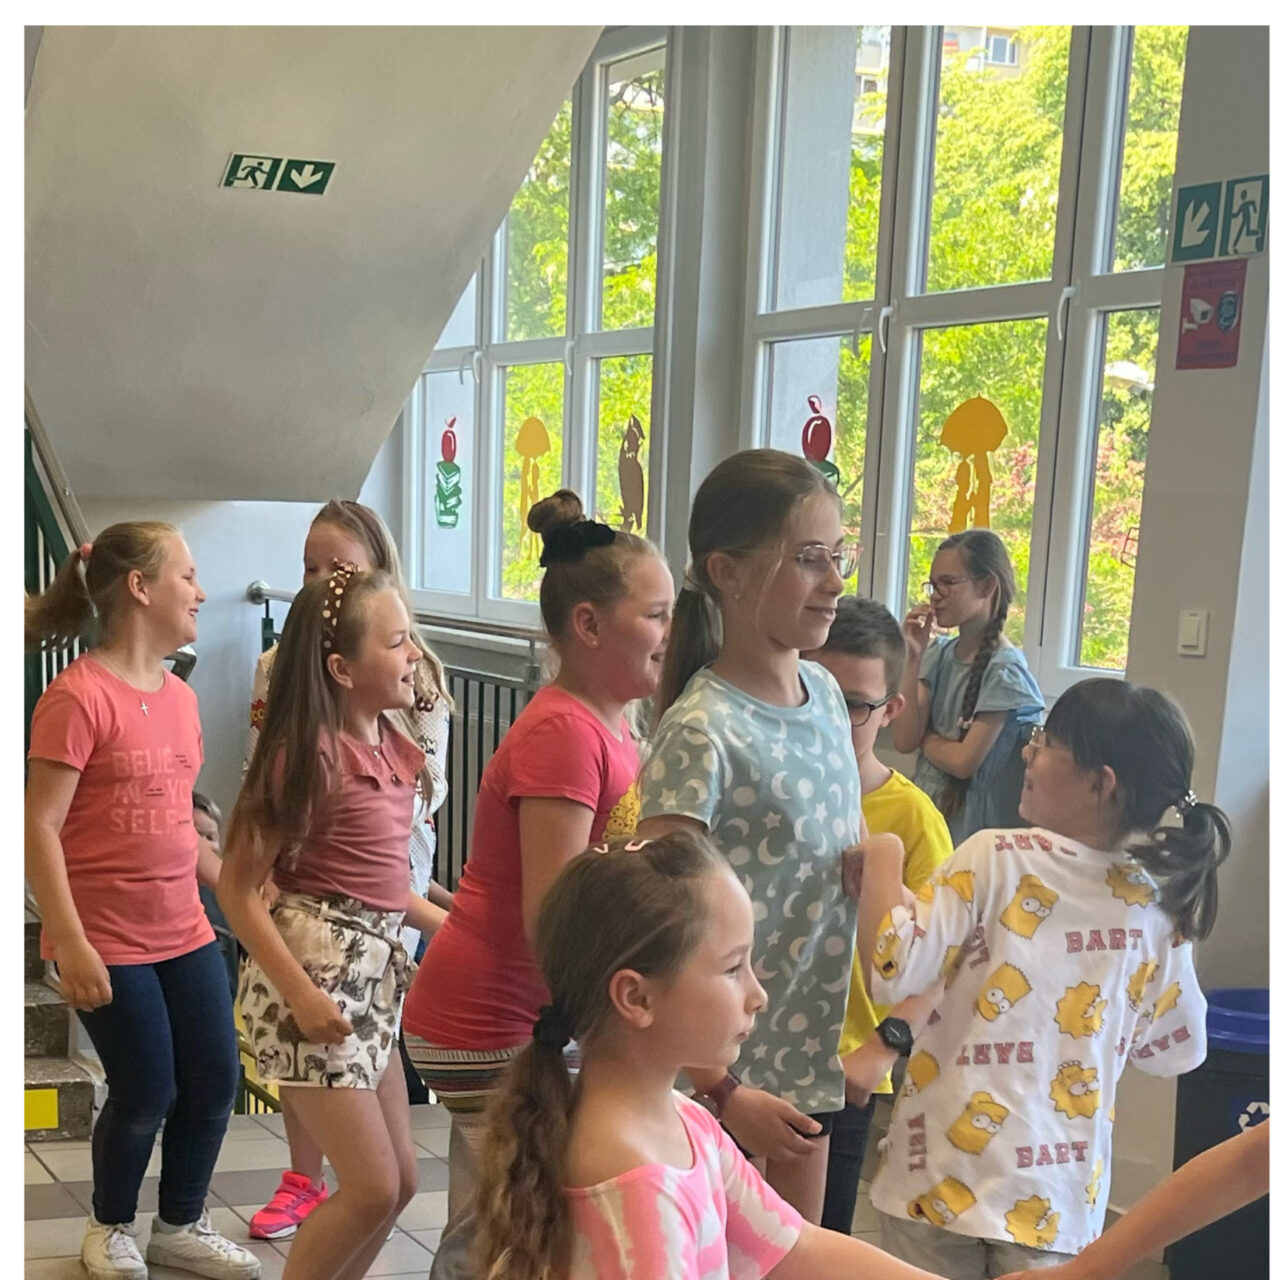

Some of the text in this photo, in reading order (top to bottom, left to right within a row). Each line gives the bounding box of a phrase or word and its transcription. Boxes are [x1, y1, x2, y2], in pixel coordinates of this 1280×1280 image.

[1066, 928, 1144, 954] BART
[956, 1041, 1035, 1067] BART
[907, 1111, 927, 1172] LISA
[1015, 1141, 1089, 1169] BART
